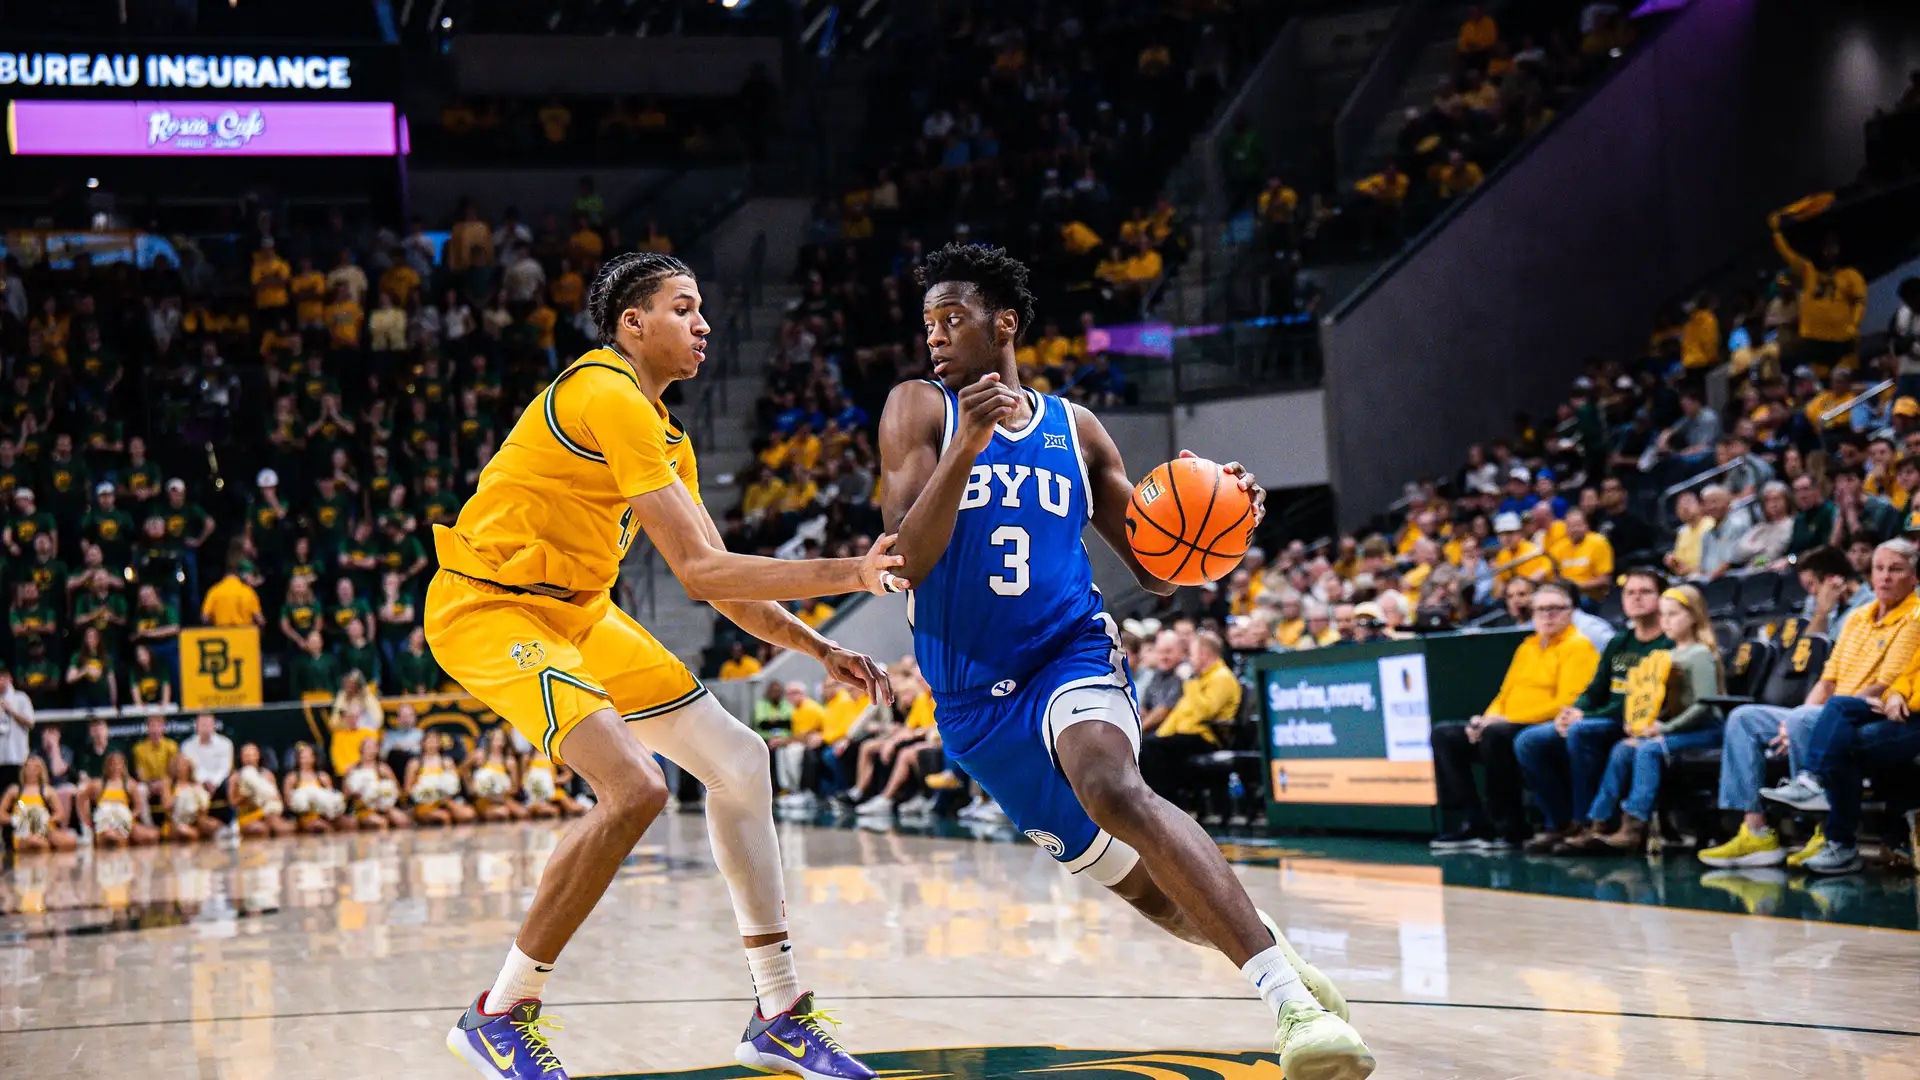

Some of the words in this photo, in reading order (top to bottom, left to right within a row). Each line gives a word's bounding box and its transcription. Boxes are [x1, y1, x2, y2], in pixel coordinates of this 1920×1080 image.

[0, 52, 139, 86] BUREAU
[146, 54, 352, 88] INSURANCE
[959, 463, 1072, 518] BYU
[989, 525, 1031, 597] 3
[196, 637, 244, 691] BU
